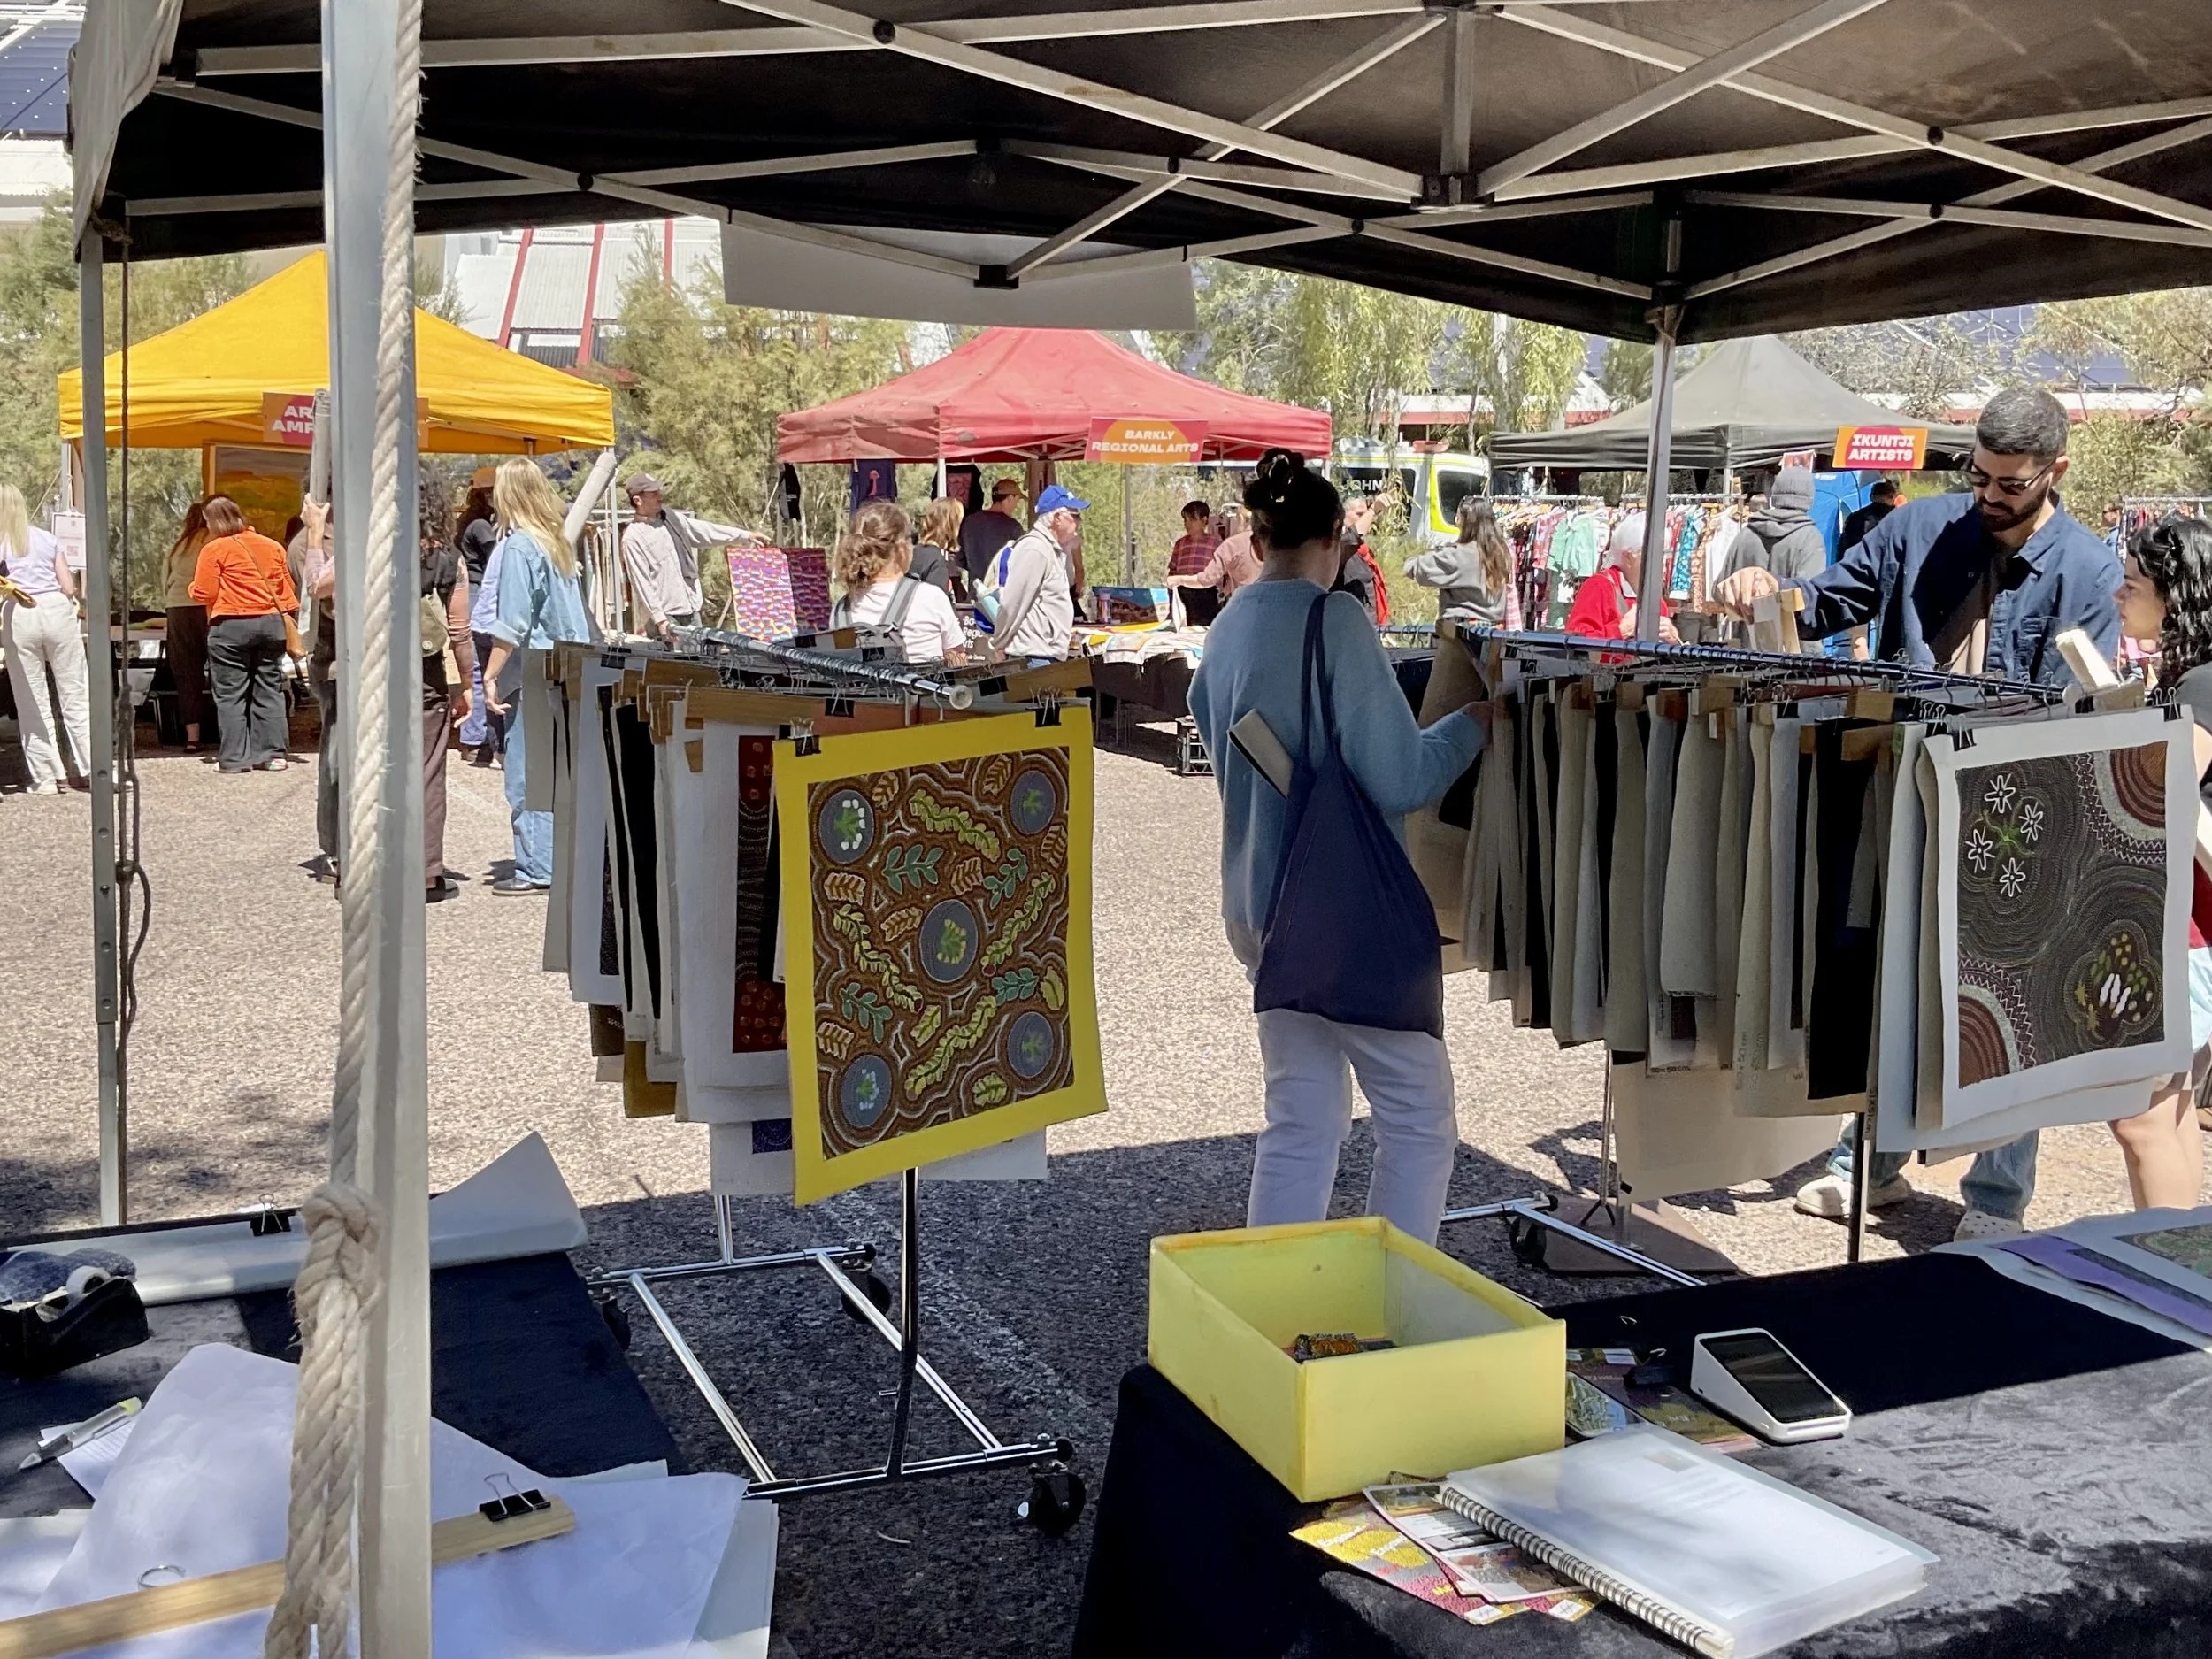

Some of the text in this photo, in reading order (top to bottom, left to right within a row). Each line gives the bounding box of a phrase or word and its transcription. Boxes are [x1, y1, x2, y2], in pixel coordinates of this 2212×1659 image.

[1125, 429, 1175, 440] BARKLY
[1851, 434, 1916, 448] IKUNTJI
[1091, 442, 1199, 454] REGIONAL ARTS
[1848, 449, 1913, 462] ARTISTS
